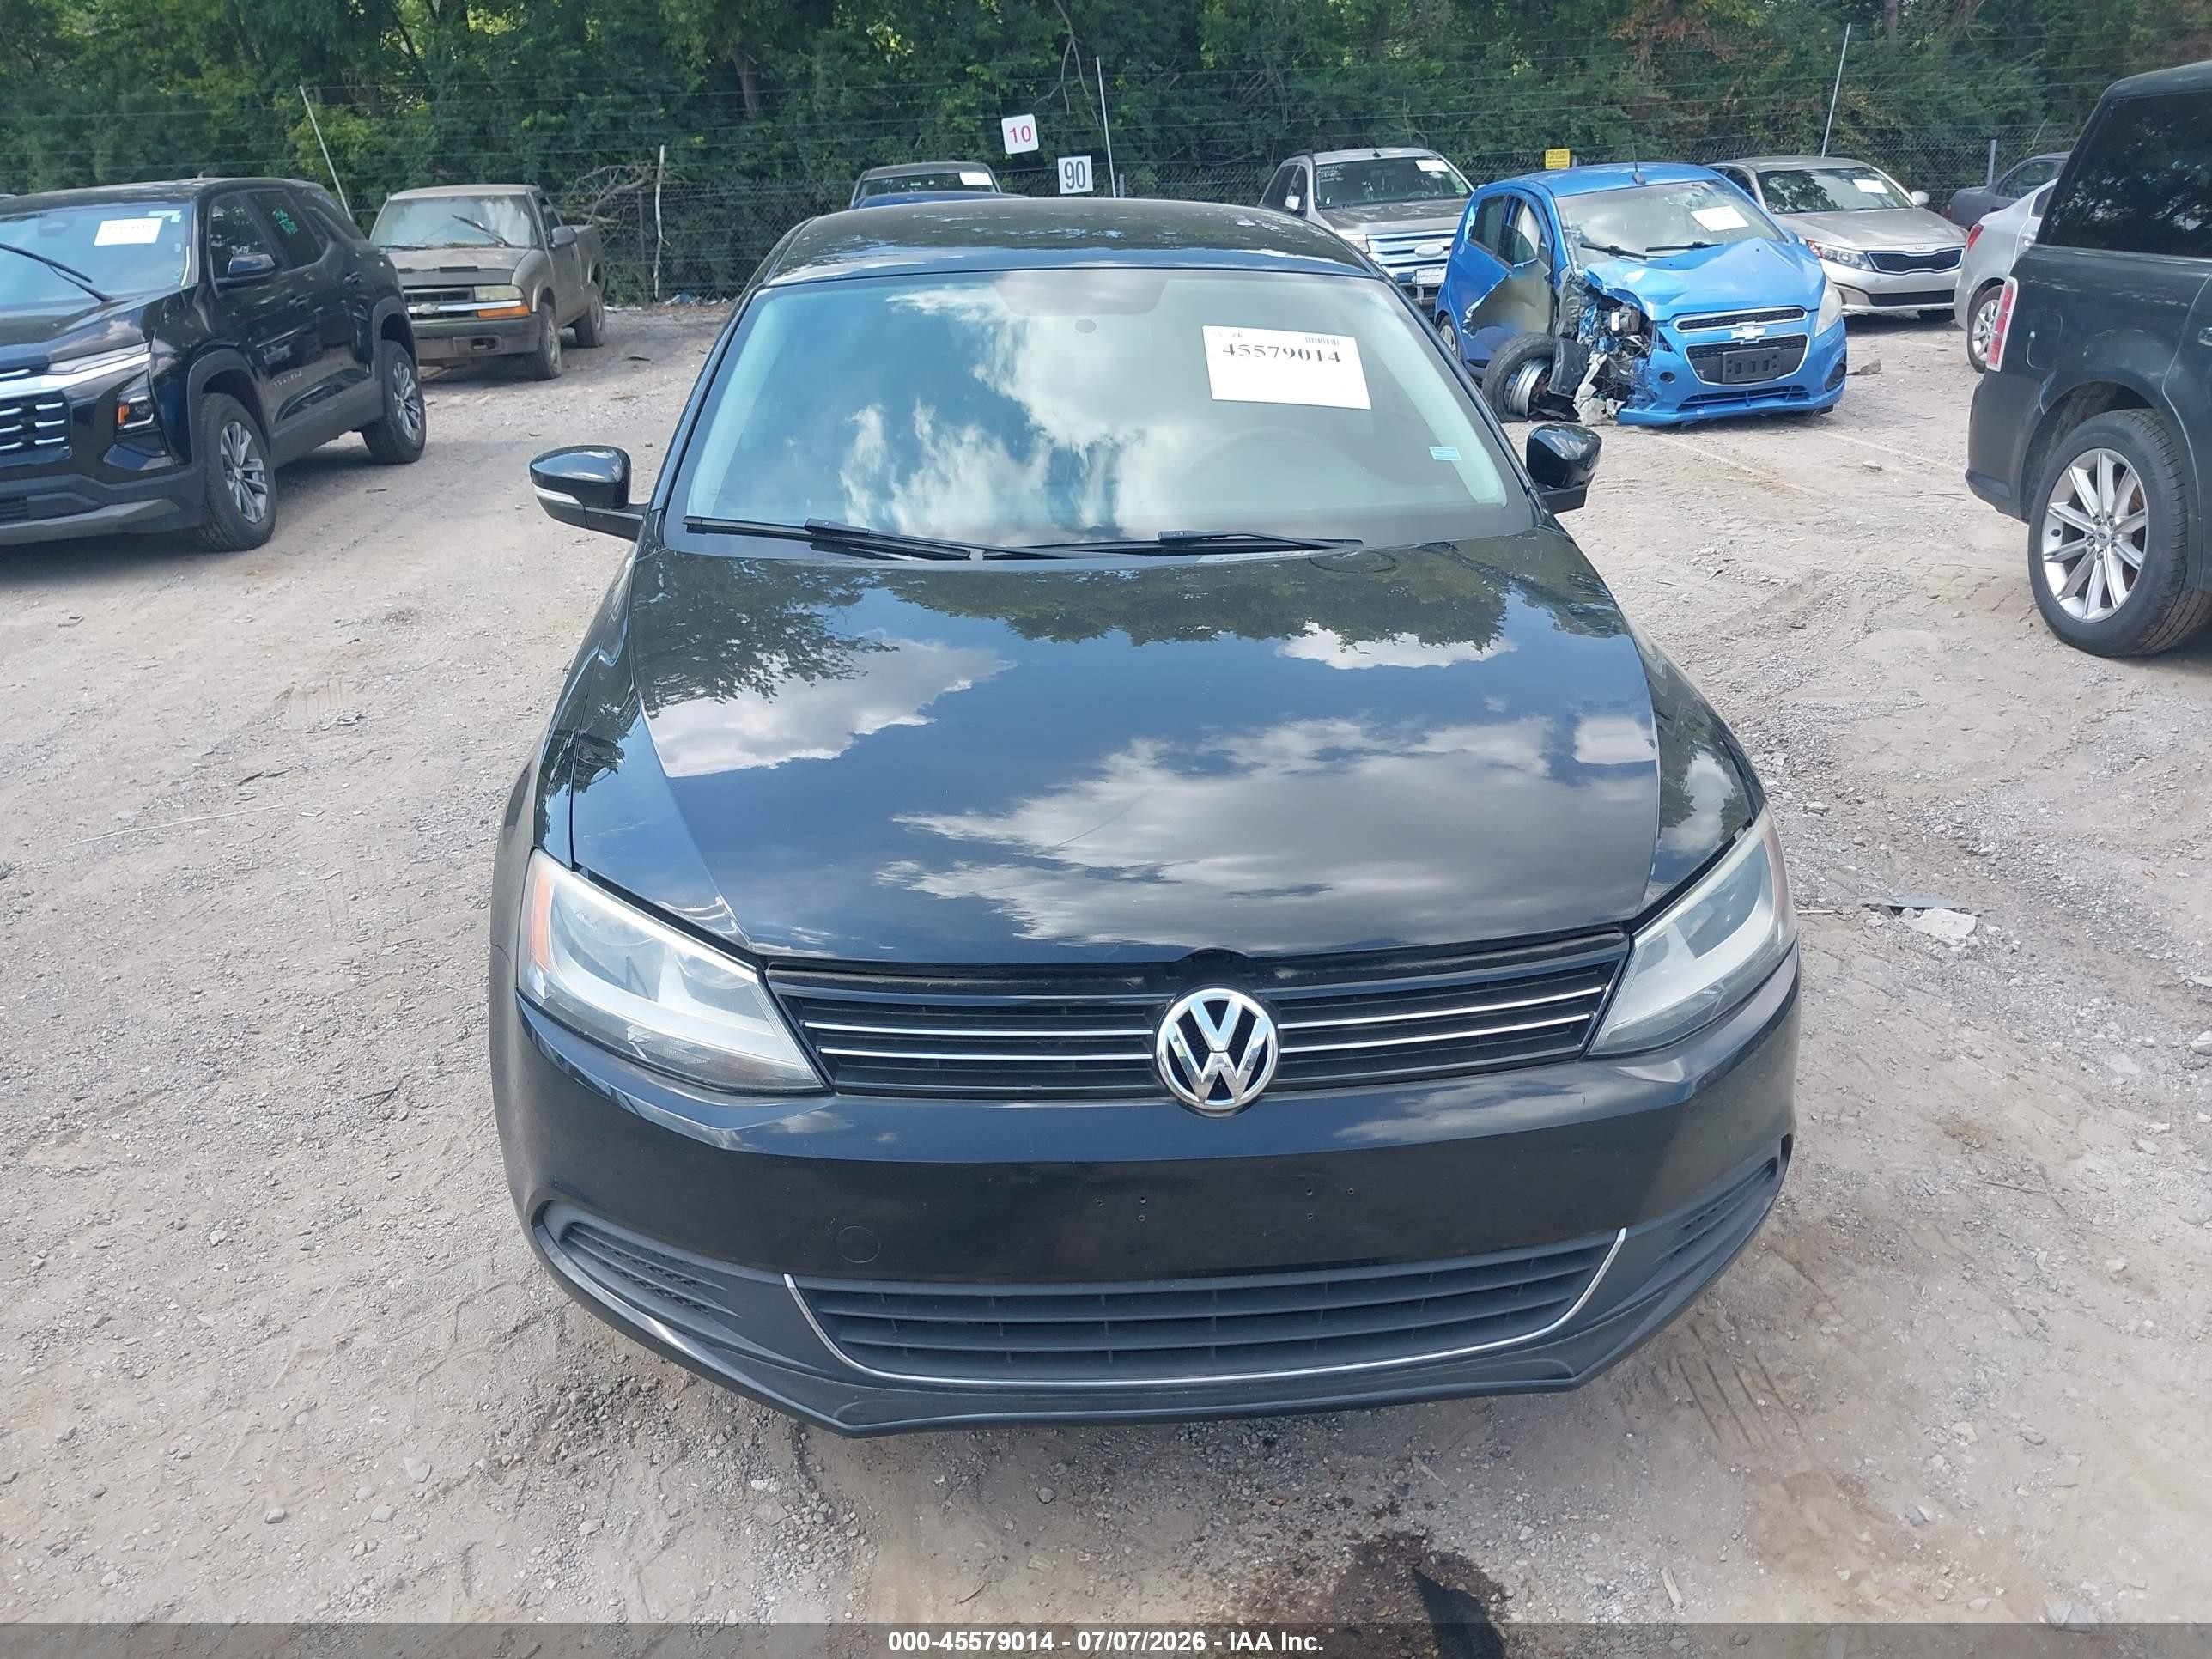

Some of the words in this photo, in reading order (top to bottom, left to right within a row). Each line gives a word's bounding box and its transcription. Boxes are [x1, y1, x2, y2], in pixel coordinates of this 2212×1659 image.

[1010, 125, 1031, 143] 10
[1064, 161, 1086, 190] 90
[1223, 343, 1340, 362] 45579014
[1165, 994, 1269, 1106] VW
